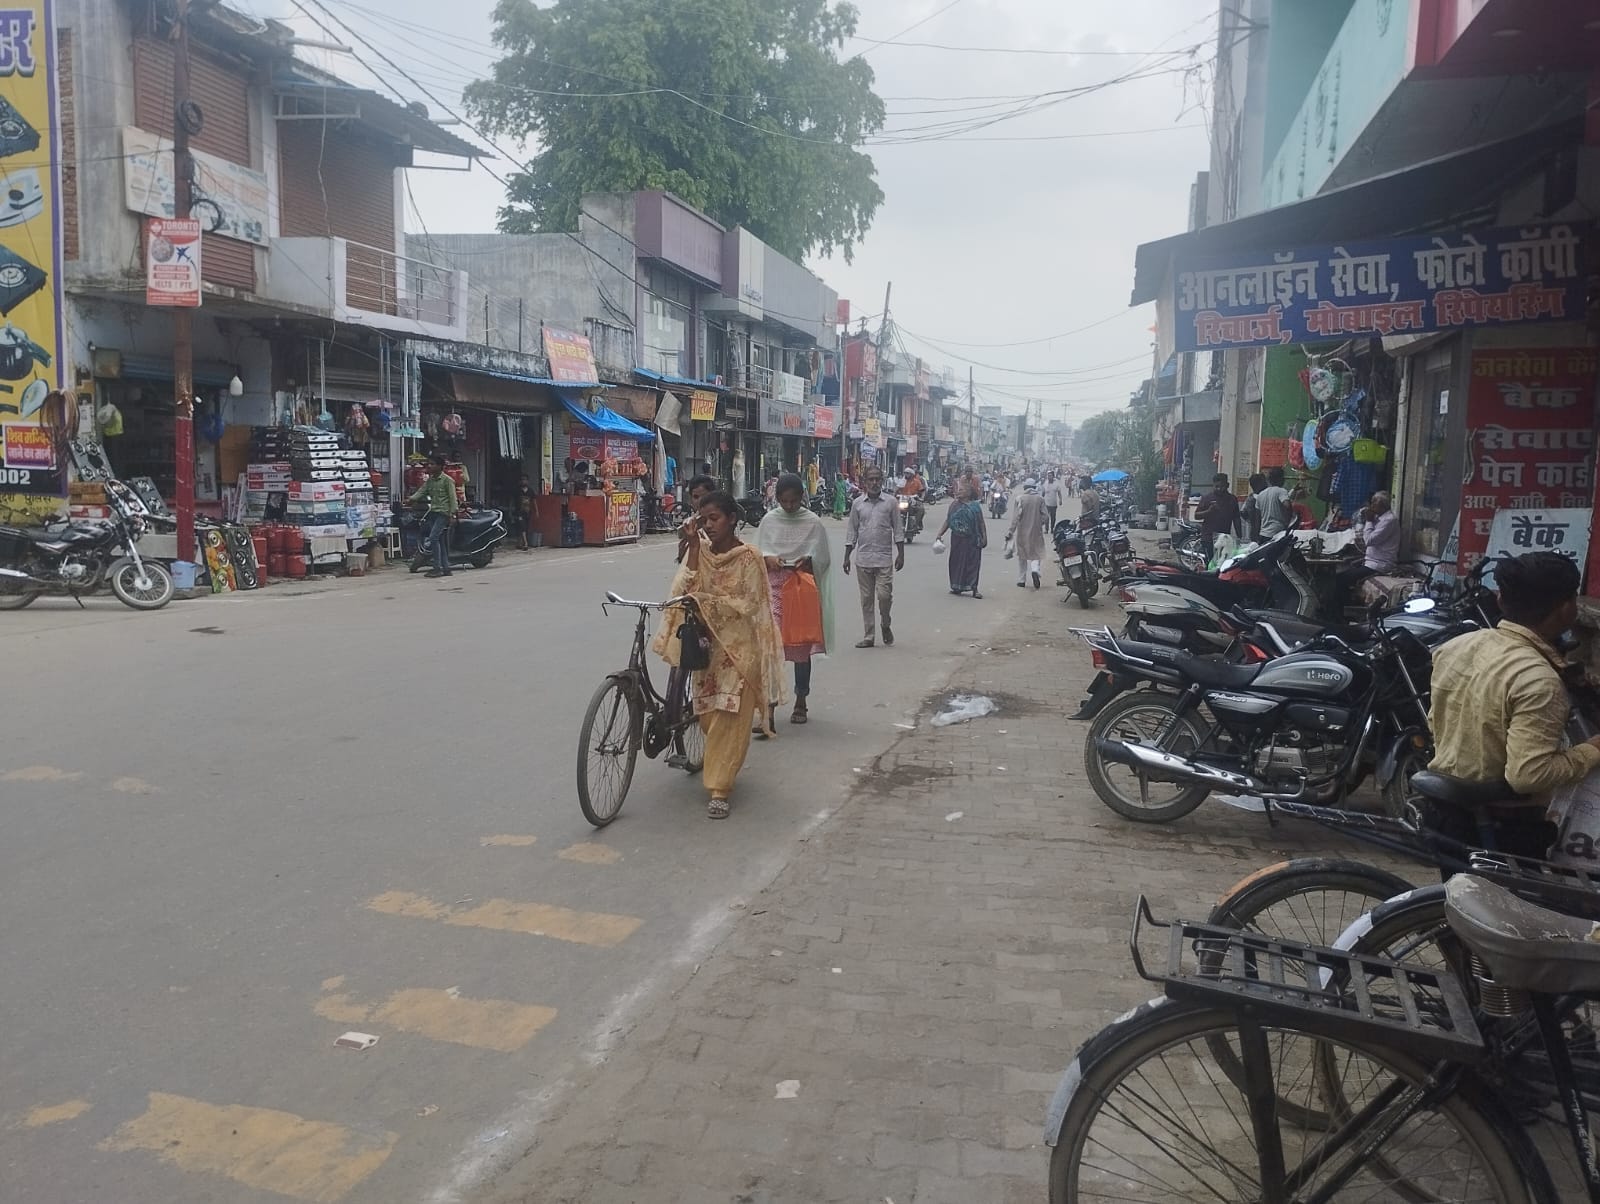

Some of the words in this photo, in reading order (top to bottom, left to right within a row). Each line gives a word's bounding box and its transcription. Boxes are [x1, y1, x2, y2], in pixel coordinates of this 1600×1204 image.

[162, 221, 198, 231] TORONTO
[1328, 246, 1399, 301] सेवा,
[1413, 234, 1487, 289] फोटो
[1498, 225, 1579, 281] कॉपी
[1304, 300, 1425, 335] मोबाइल
[1432, 282, 1567, 326] रिपेयरिंग
[1473, 352, 1557, 377] जनसेवा
[1497, 379, 1584, 408] बैंक
[7, 427, 23, 442] शिव
[1480, 455, 1525, 487] पेन
[1511, 515, 1570, 548] बैंक
[1318, 672, 1341, 681] Hero
[1567, 832, 1600, 860] a
